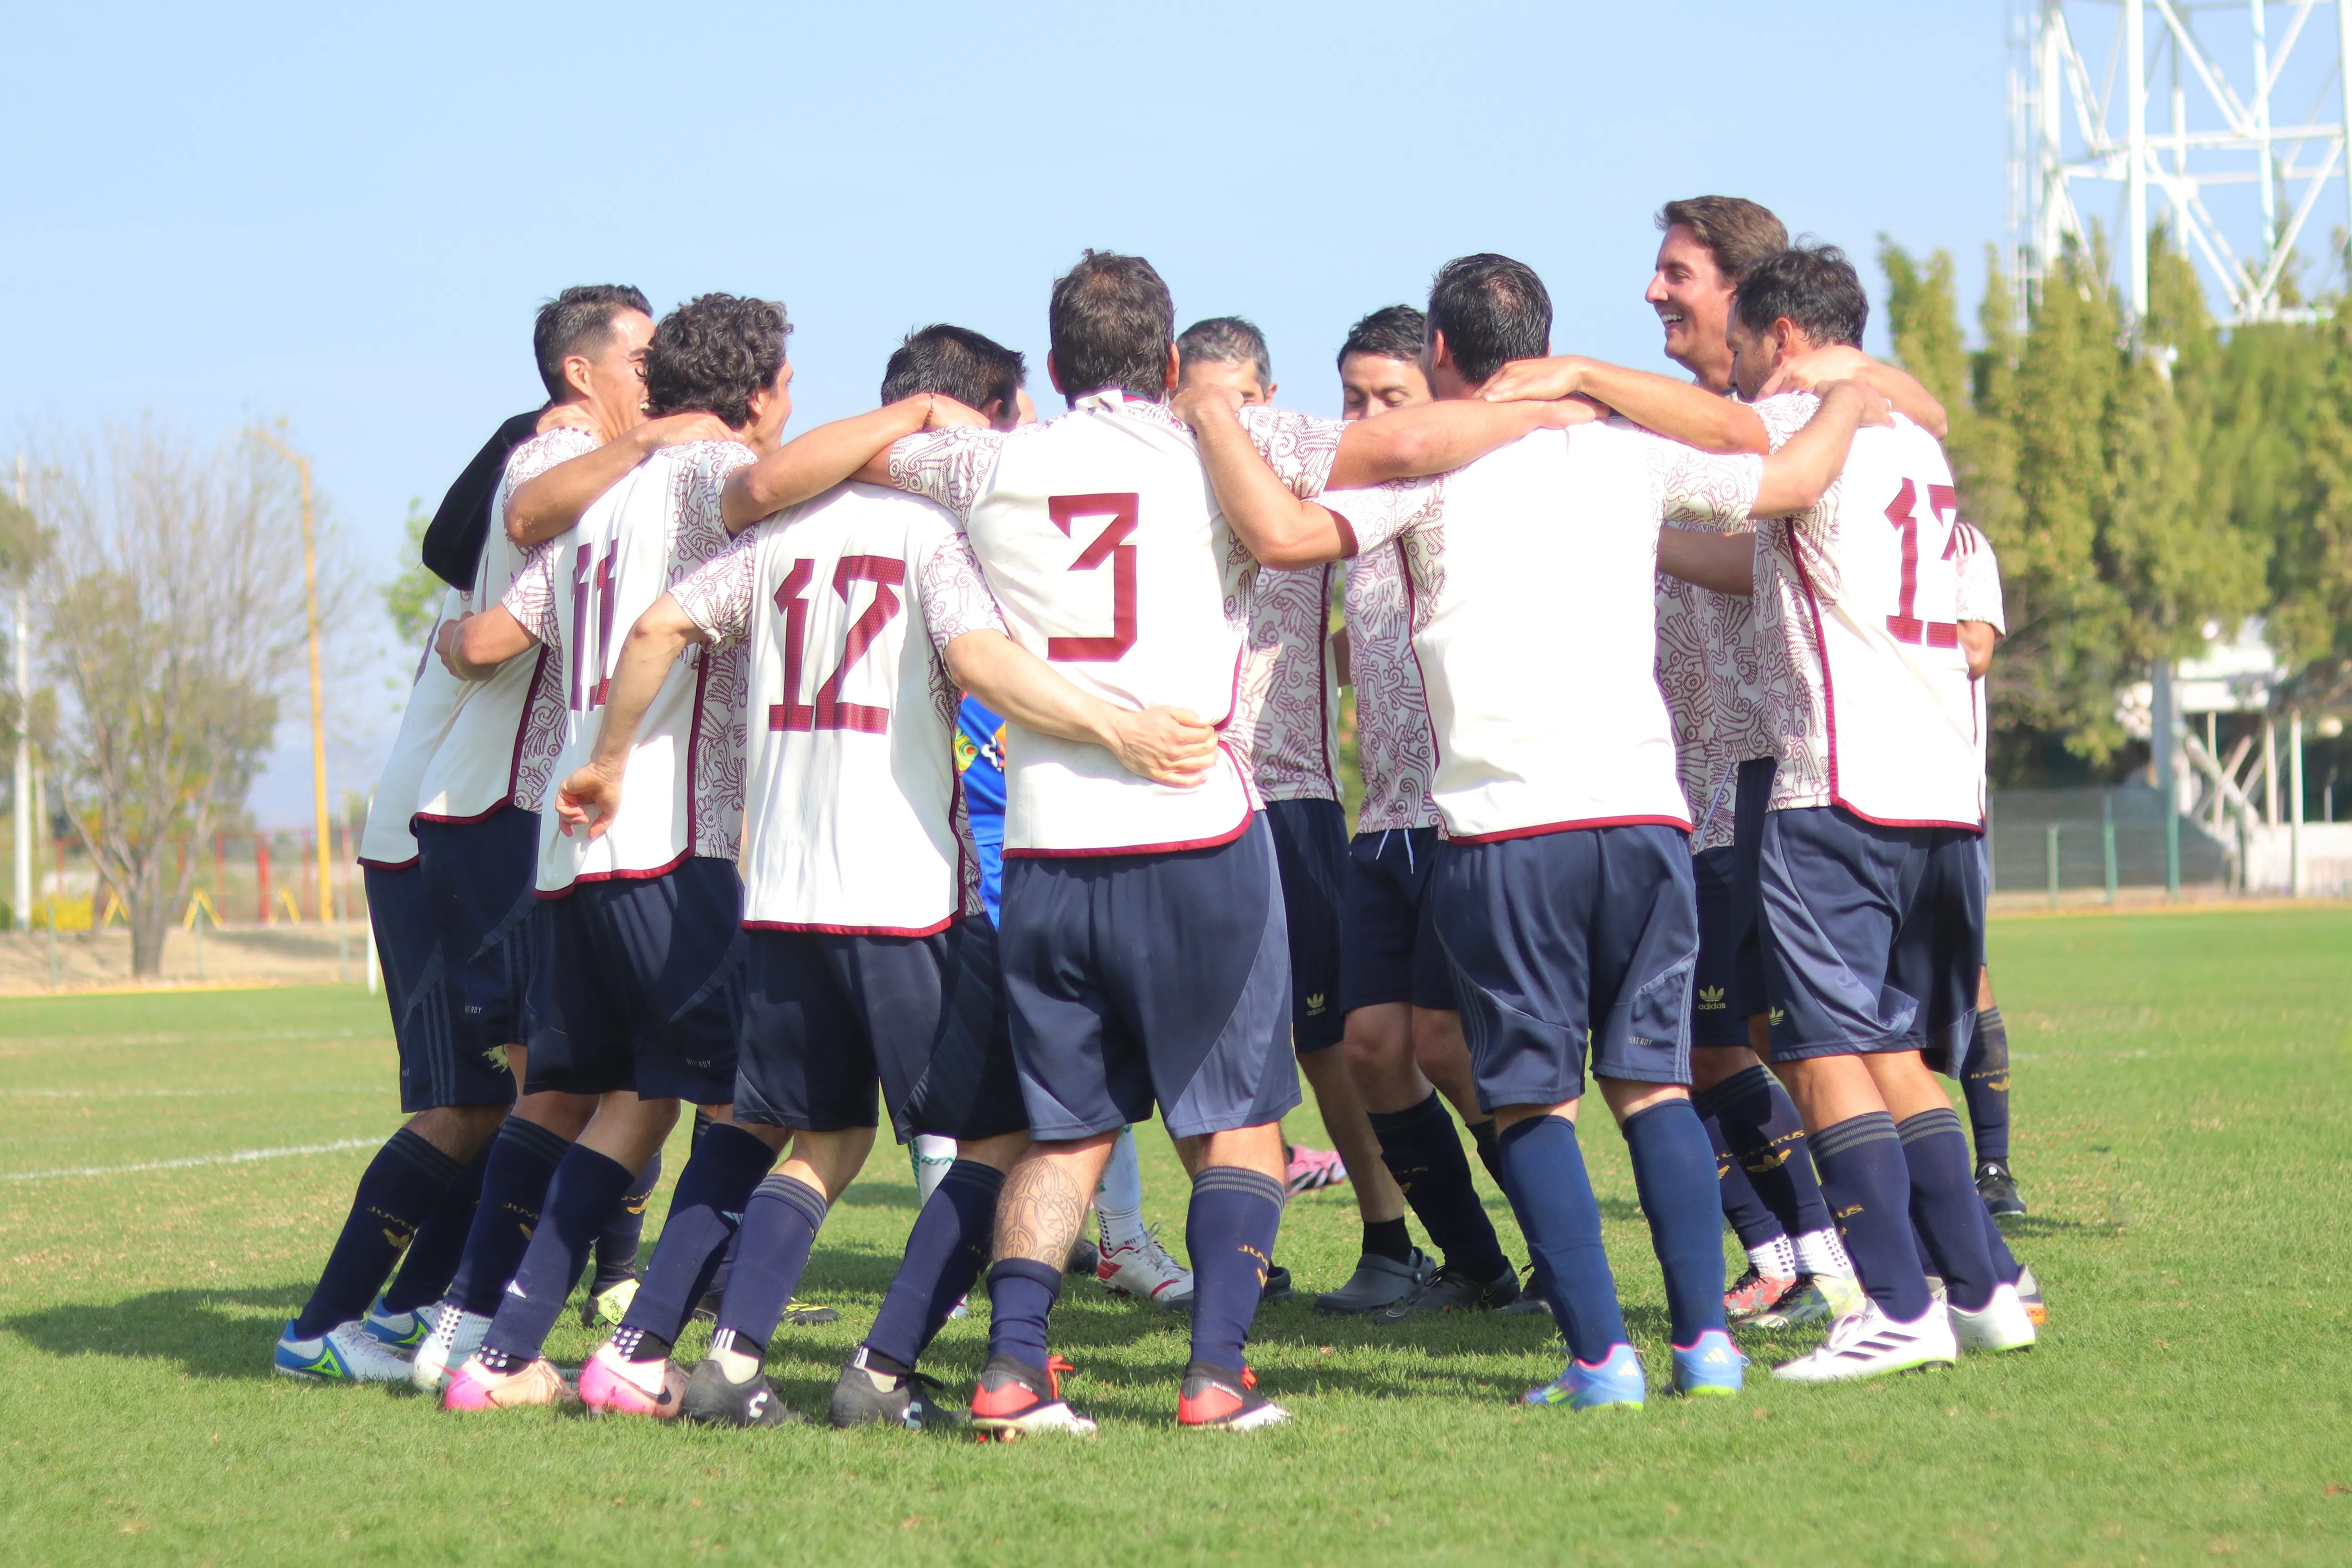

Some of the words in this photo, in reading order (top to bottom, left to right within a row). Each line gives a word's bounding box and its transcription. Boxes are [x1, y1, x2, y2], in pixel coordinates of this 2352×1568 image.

[570, 538, 619, 711] 11
[769, 555, 906, 736] 12
[1047, 493, 1139, 662] 3
